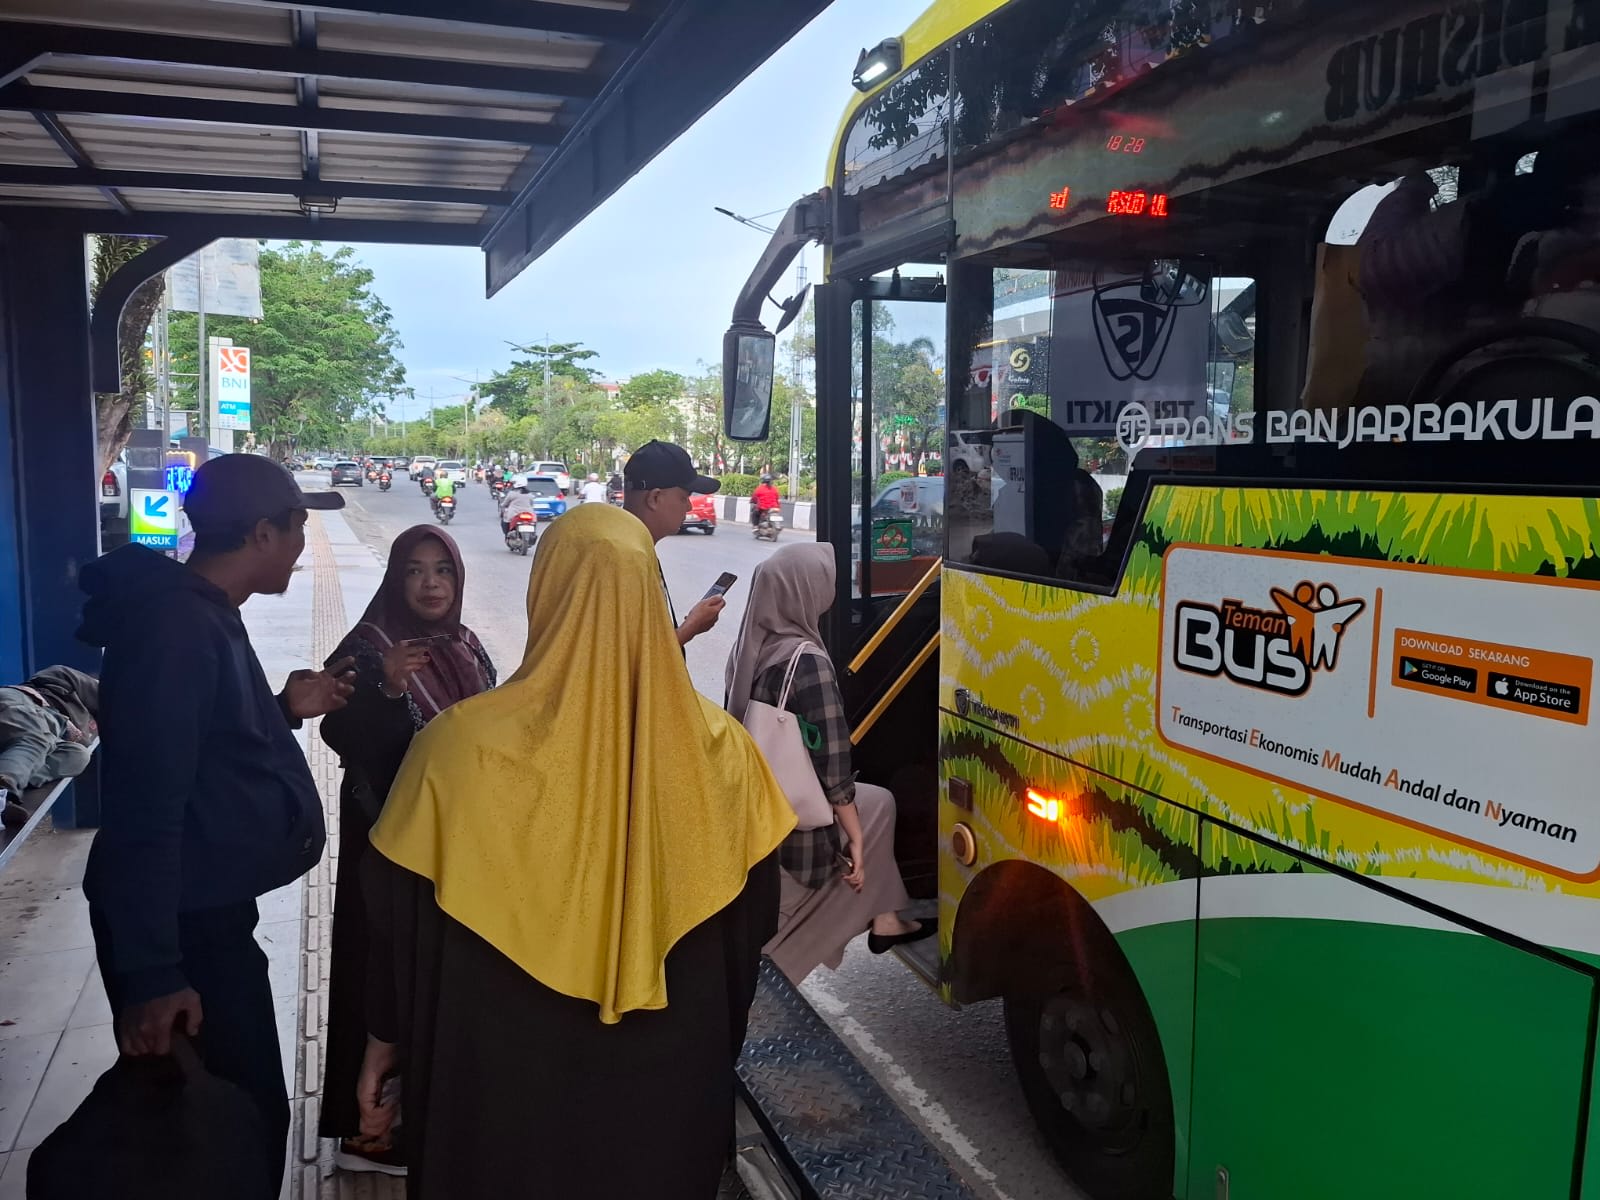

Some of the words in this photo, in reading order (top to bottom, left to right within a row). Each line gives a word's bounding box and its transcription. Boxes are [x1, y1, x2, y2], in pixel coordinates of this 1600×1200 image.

[221, 376, 247, 390] BNI
[220, 402, 236, 411] ATM
[1155, 411, 1256, 447] TRANS
[1266, 396, 1600, 450] BANJARBAKULA
[136, 535, 171, 546] MASUK
[1224, 604, 1286, 635] Teman
[1400, 636, 1463, 656] DOWNLOAD
[1467, 647, 1531, 667] SEKARANG
[1421, 669, 1452, 685] Google
[1453, 675, 1471, 689] Play
[1515, 679, 1548, 691] Download
[1559, 687, 1571, 695] the
[1513, 688, 1538, 704] App
[1539, 692, 1571, 708] Store
[1171, 705, 1248, 744] Transportasi
[1249, 728, 1319, 766] Ekonomis
[1321, 750, 1382, 784] Mudah
[1383, 768, 1442, 802] Andal
[1442, 789, 1481, 814] dan
[1484, 799, 1577, 844] Nyaman
